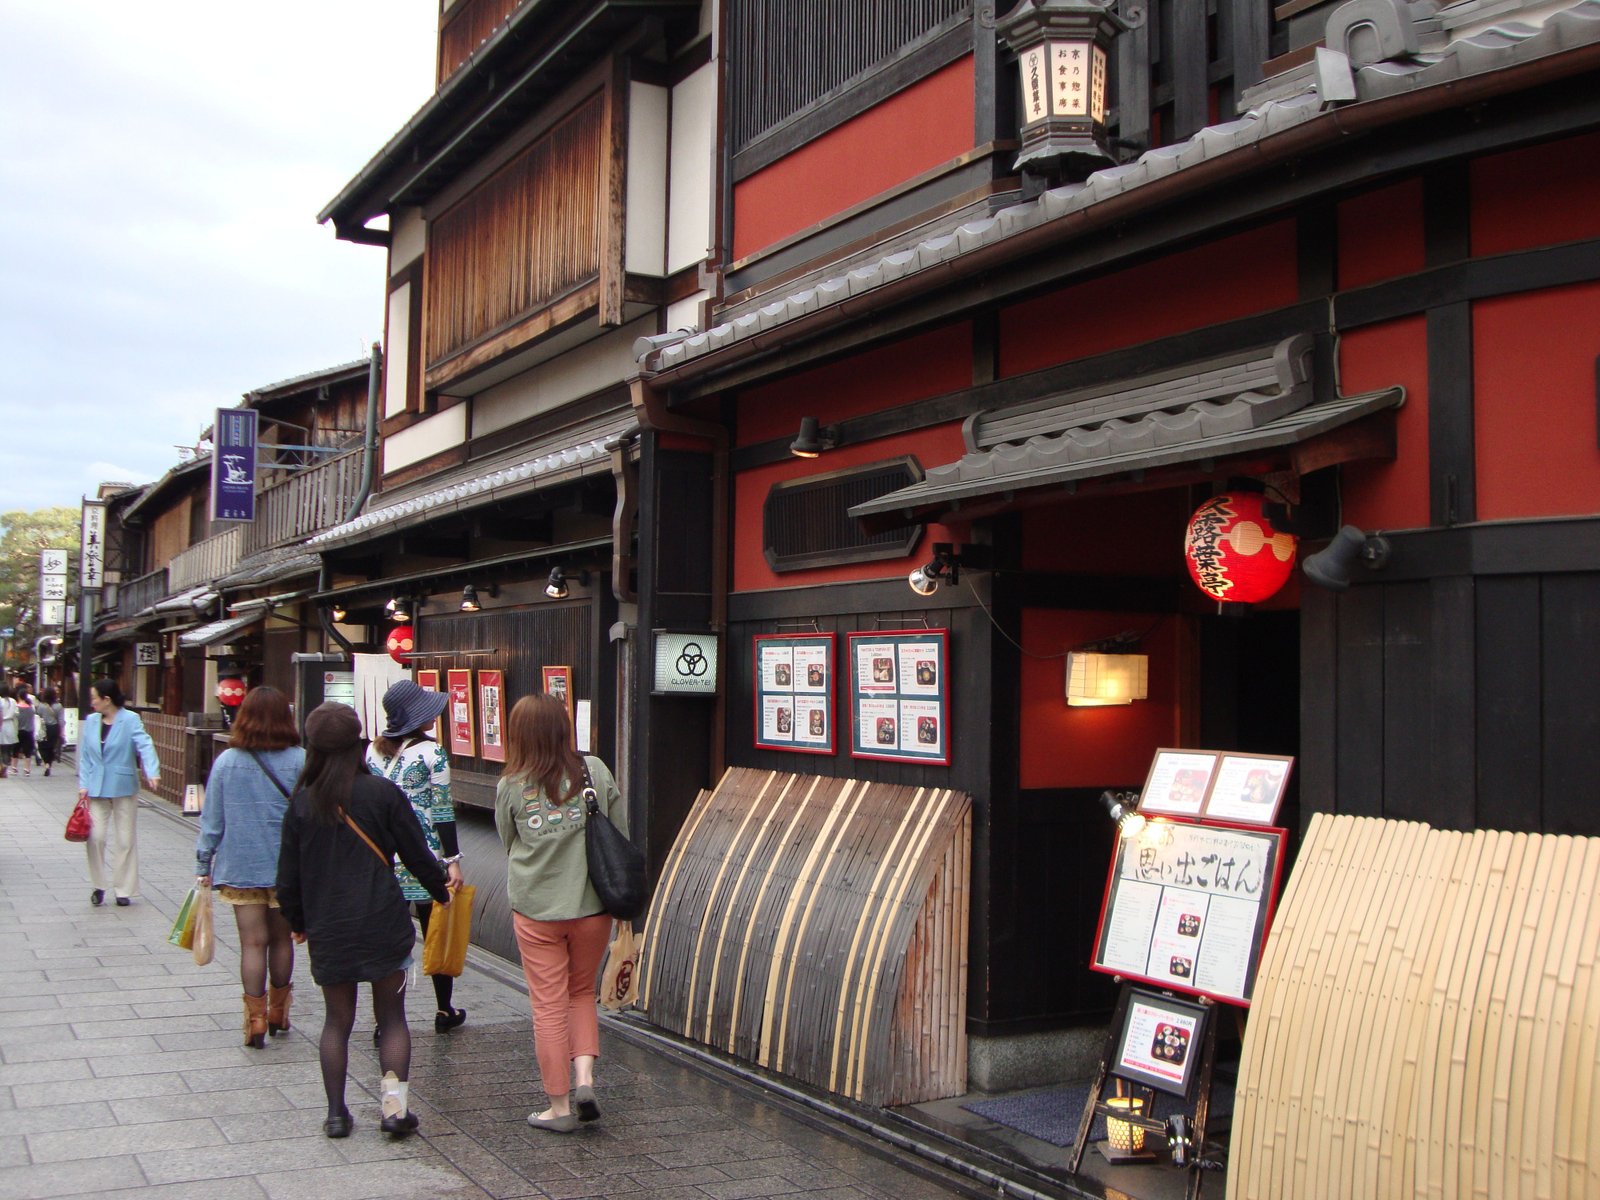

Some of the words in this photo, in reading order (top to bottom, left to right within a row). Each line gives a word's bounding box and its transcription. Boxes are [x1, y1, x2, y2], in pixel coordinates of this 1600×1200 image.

[1135, 847, 1262, 894] 思い出ごはん
